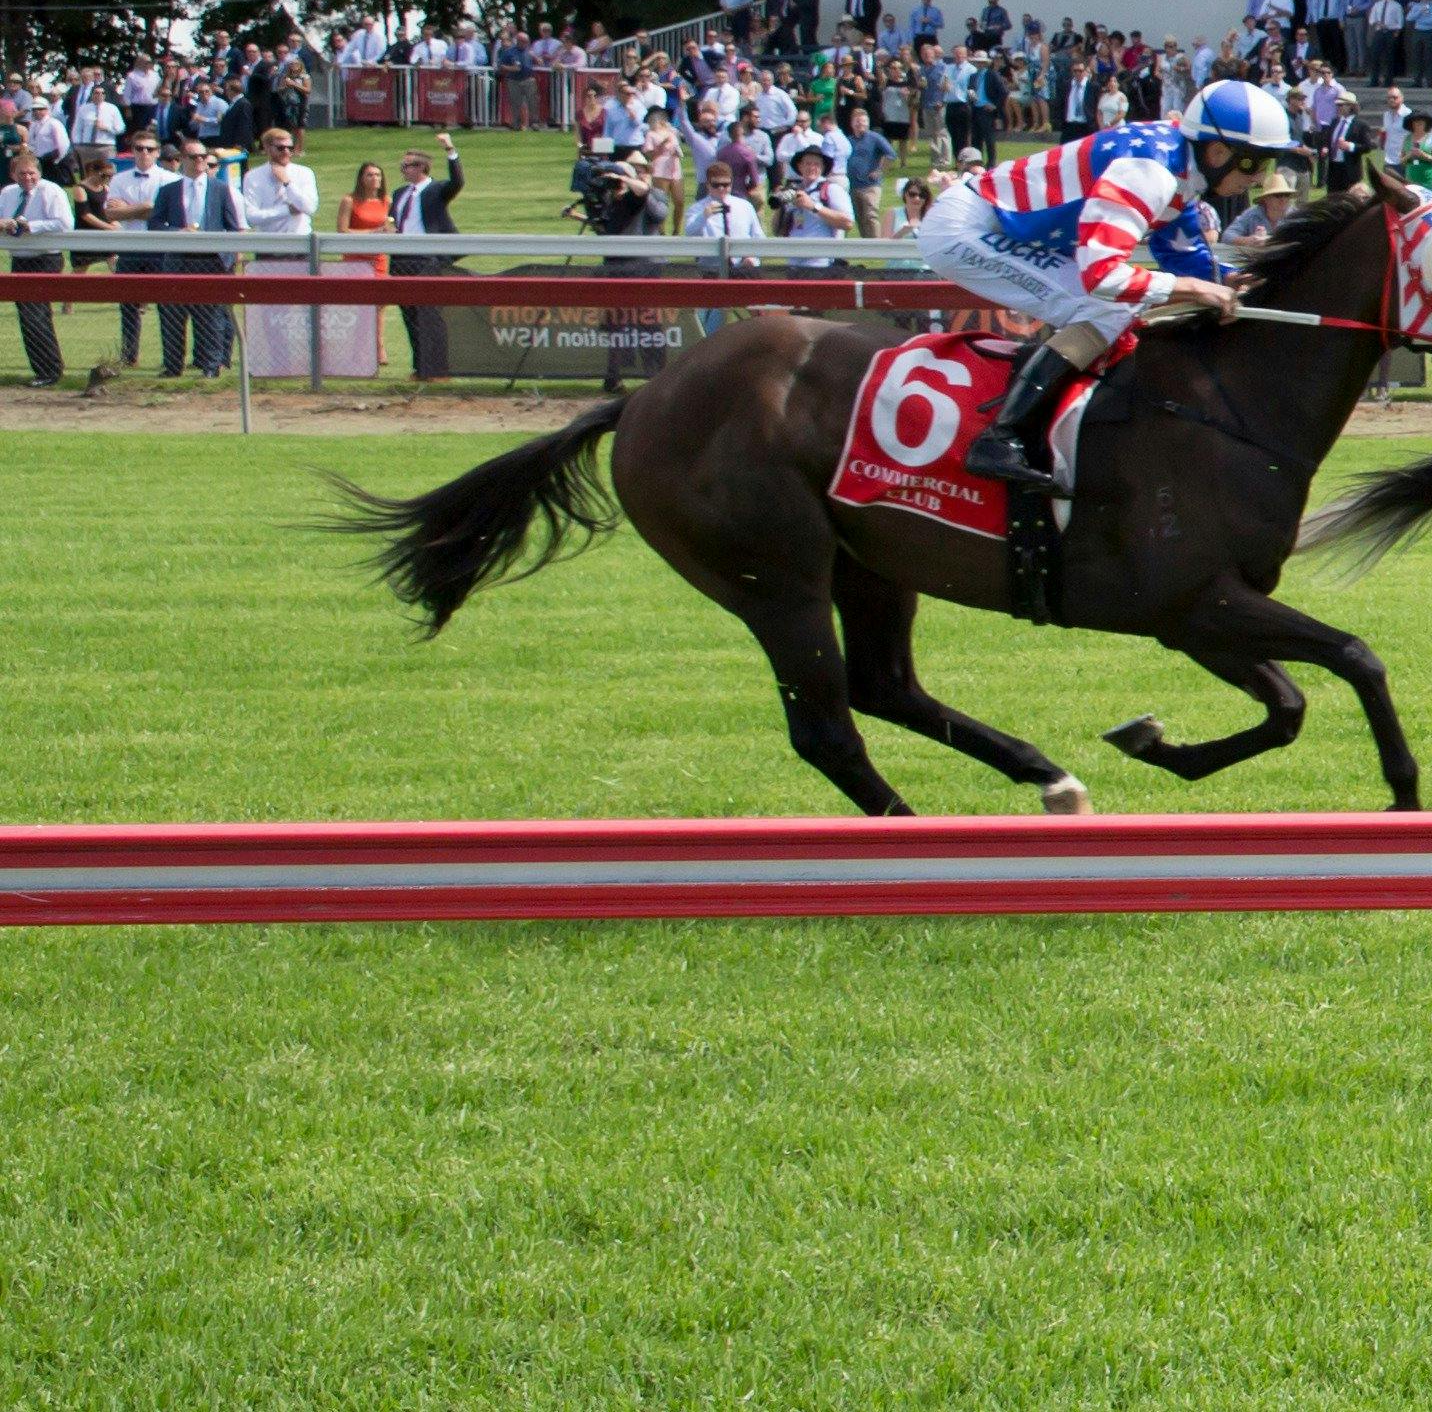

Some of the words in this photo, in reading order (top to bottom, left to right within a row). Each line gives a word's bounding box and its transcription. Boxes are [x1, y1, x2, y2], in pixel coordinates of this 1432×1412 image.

[871, 347, 973, 468] 6
[849, 459, 985, 506] COMMERCIAL
[884, 486, 942, 512] CLUB
